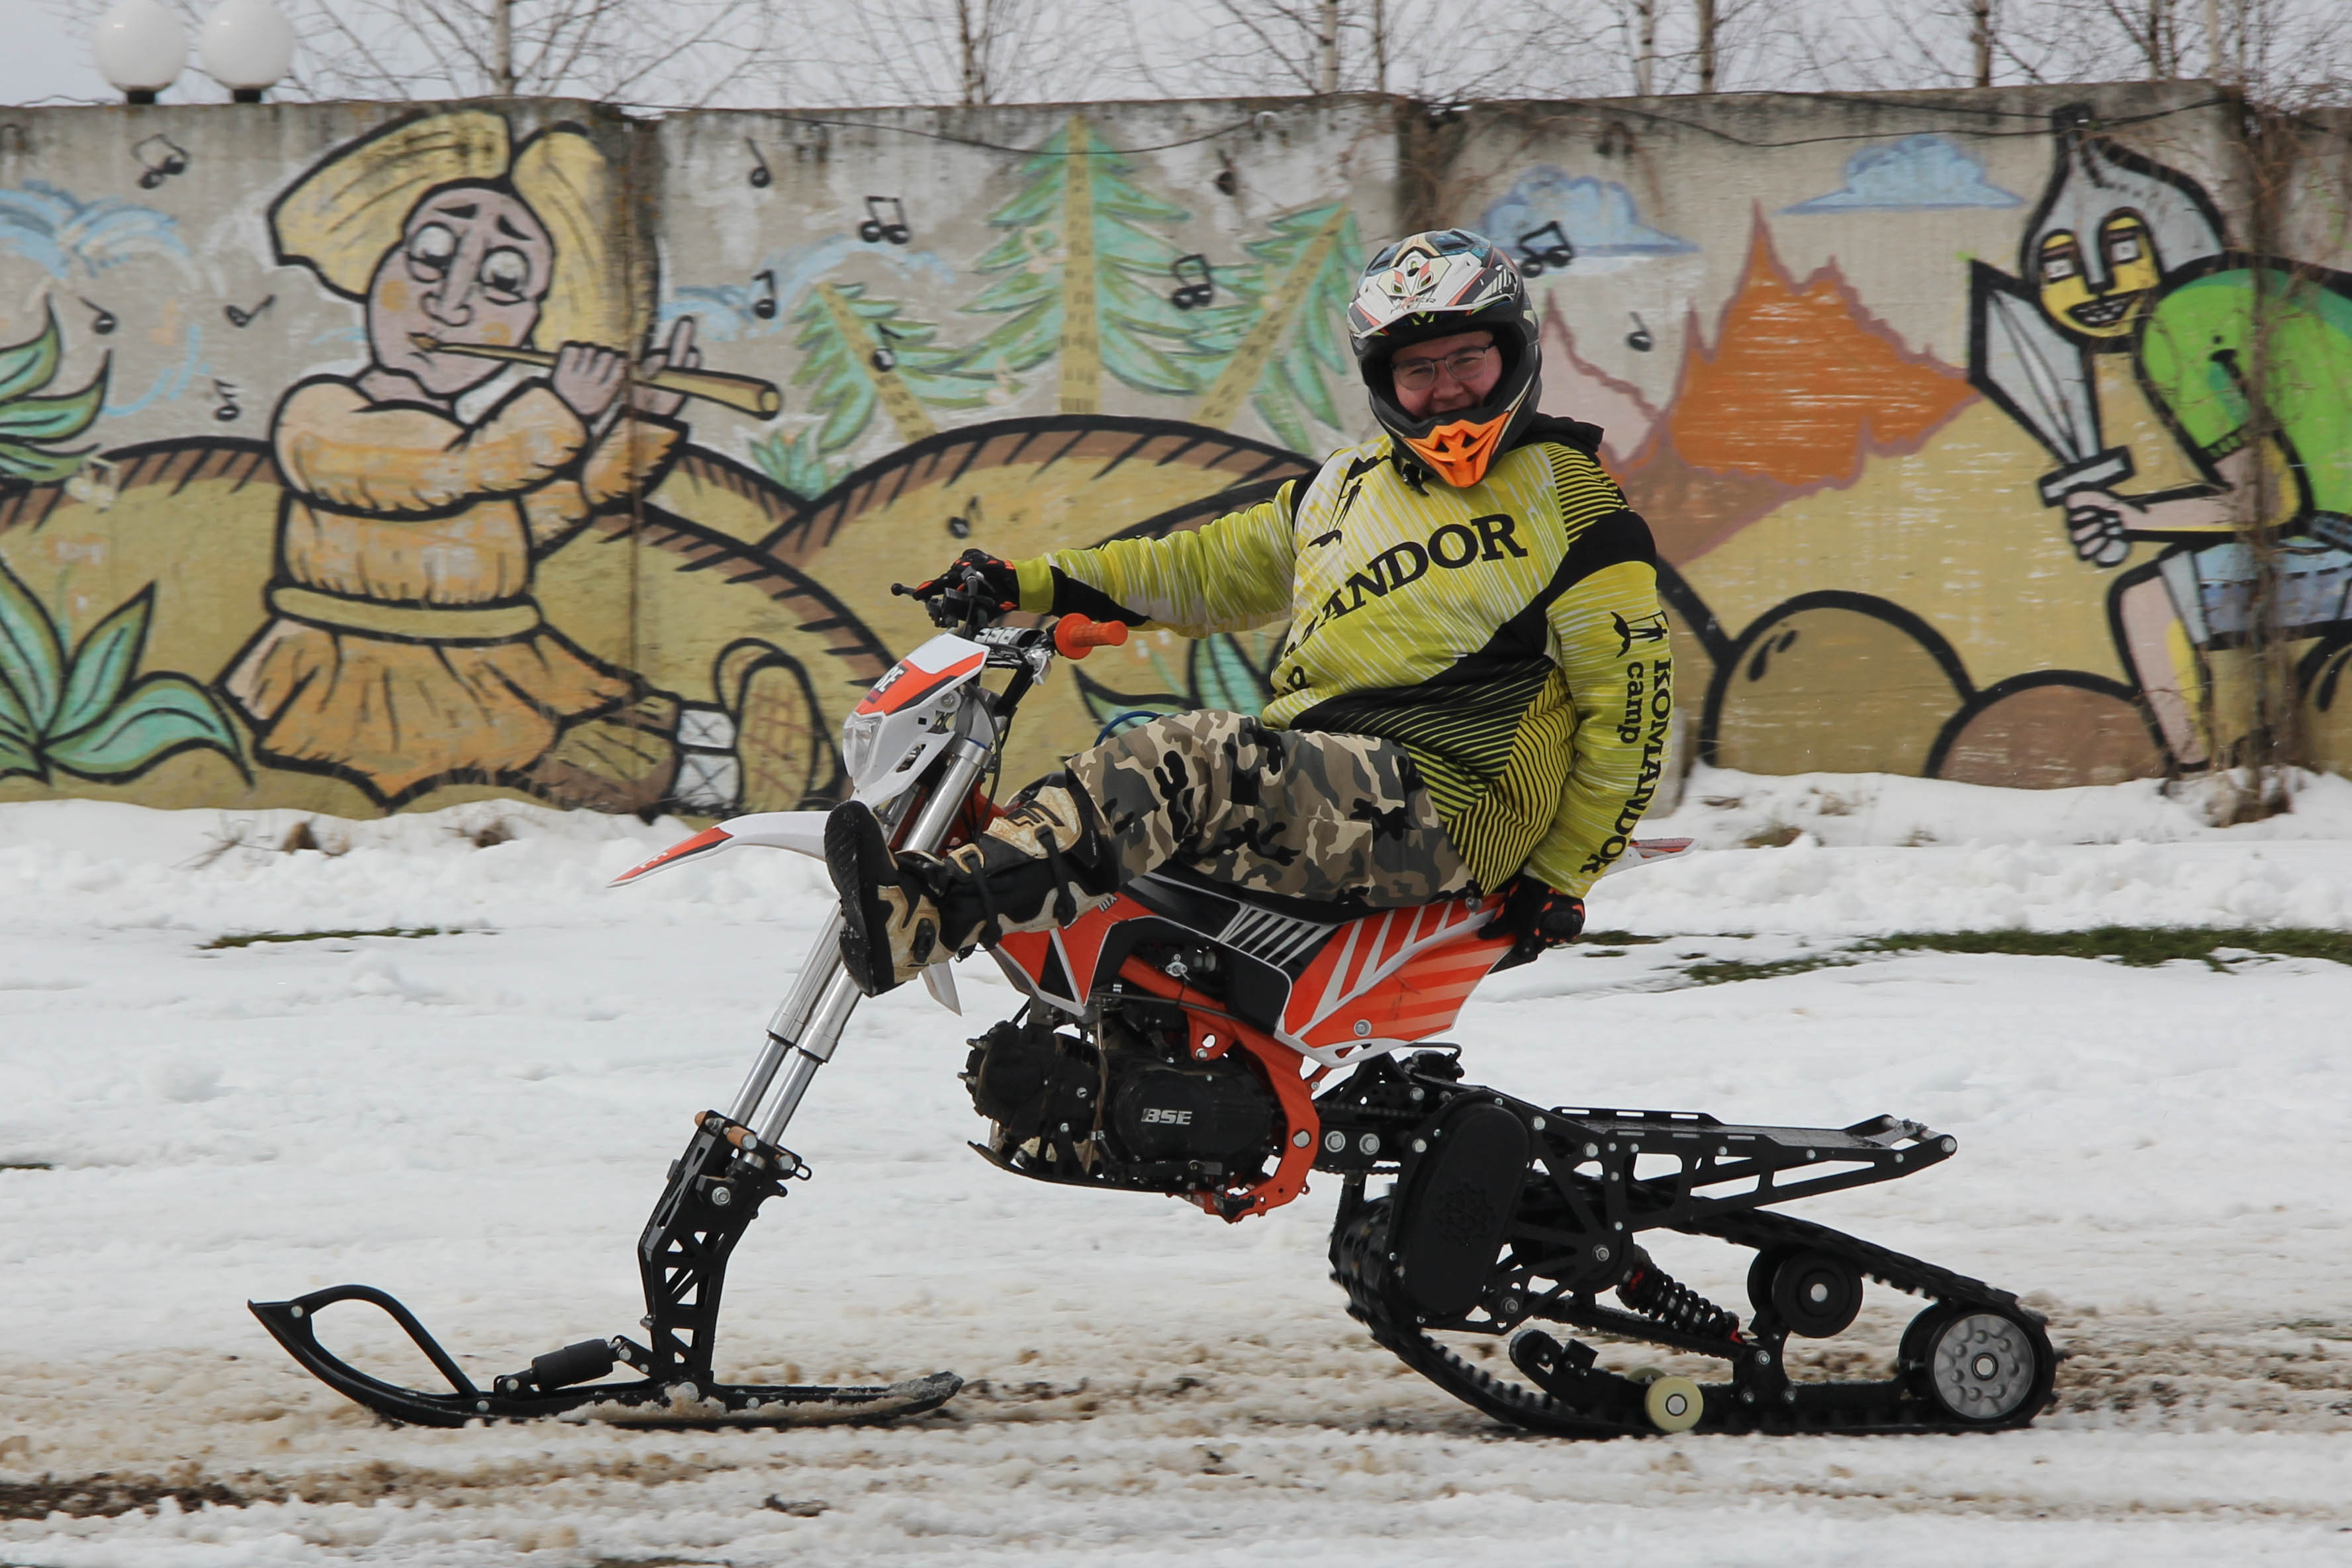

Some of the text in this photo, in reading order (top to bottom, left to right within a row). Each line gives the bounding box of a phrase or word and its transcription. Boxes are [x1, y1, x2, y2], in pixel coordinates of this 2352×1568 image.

[1284, 514, 1529, 657] ANDOR
[1617, 661, 1644, 744] camp
[1579, 658, 1671, 874] KOMANDOR
[1141, 1108, 1192, 1125] BSE
